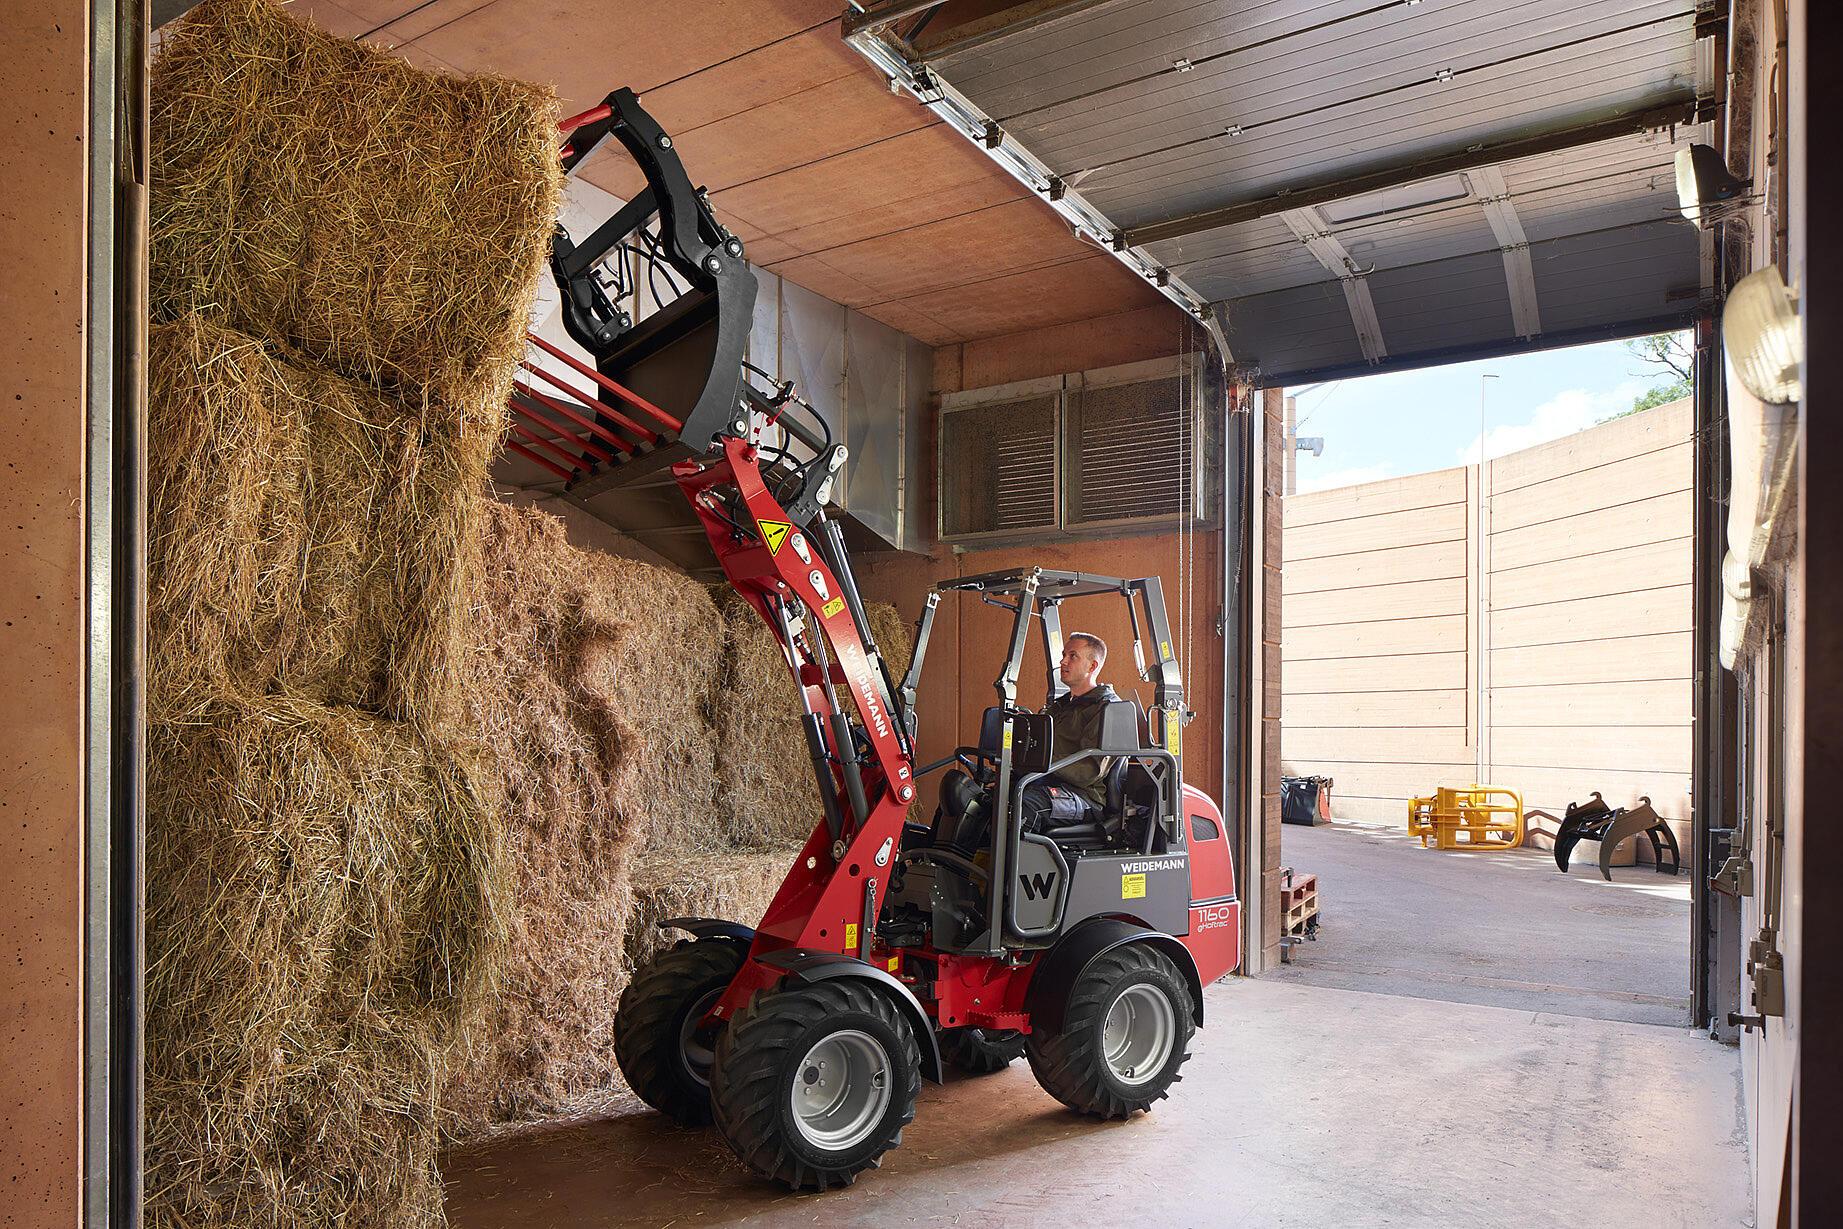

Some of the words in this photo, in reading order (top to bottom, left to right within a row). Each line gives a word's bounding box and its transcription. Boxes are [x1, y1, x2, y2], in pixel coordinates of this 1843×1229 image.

[847, 643, 889, 738] WEIDEMANN
[1121, 859, 1185, 873] WEIDEMANN
[1019, 872, 1056, 900] W
[1198, 907, 1229, 922] 1160
